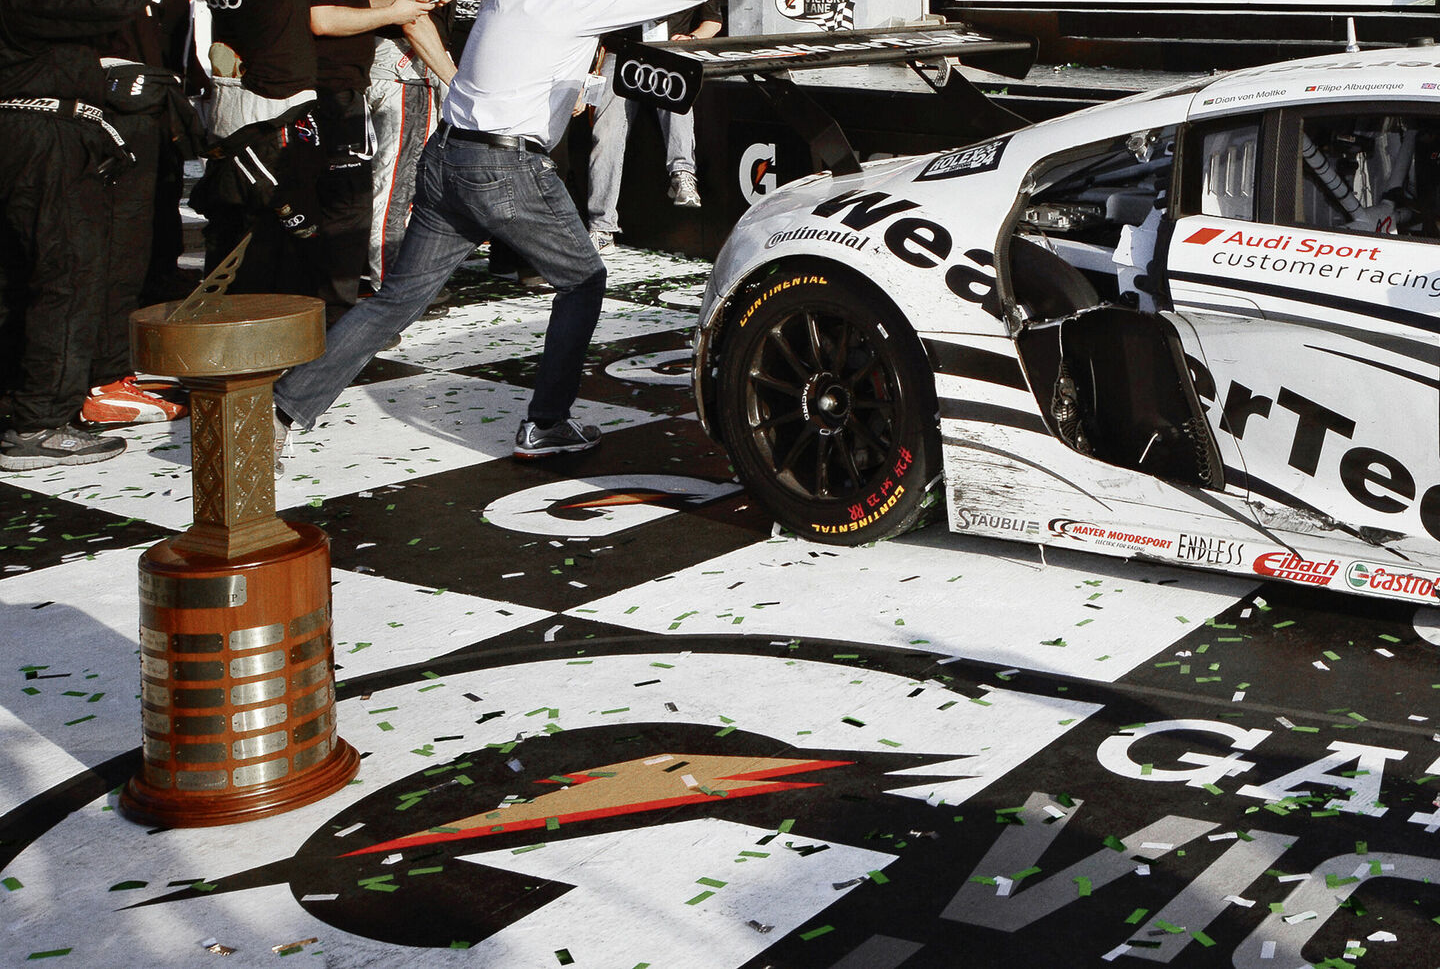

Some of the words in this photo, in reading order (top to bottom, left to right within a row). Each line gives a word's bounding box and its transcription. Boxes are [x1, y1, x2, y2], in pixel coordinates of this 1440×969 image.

[805, 4, 831, 12] LANE
[1215, 95, 1236, 104] Dion
[1255, 88, 1286, 99] Moltke
[1317, 84, 1342, 92] Filipe
[1344, 83, 1404, 91] Albuquerque
[764, 226, 870, 251] Continental
[1223, 231, 1291, 250] Audi
[1296, 239, 1381, 261] Sport
[1212, 250, 1349, 279] customer
[740, 275, 827, 327] CONTINENTAL
[812, 485, 905, 534] CONTINENTAL
[1072, 525, 1106, 537] MAYER
[1107, 531, 1173, 549] MOTORSPORT
[1177, 533, 1245, 565] ENDLESS
[1369, 568, 1440, 597] Castrol
